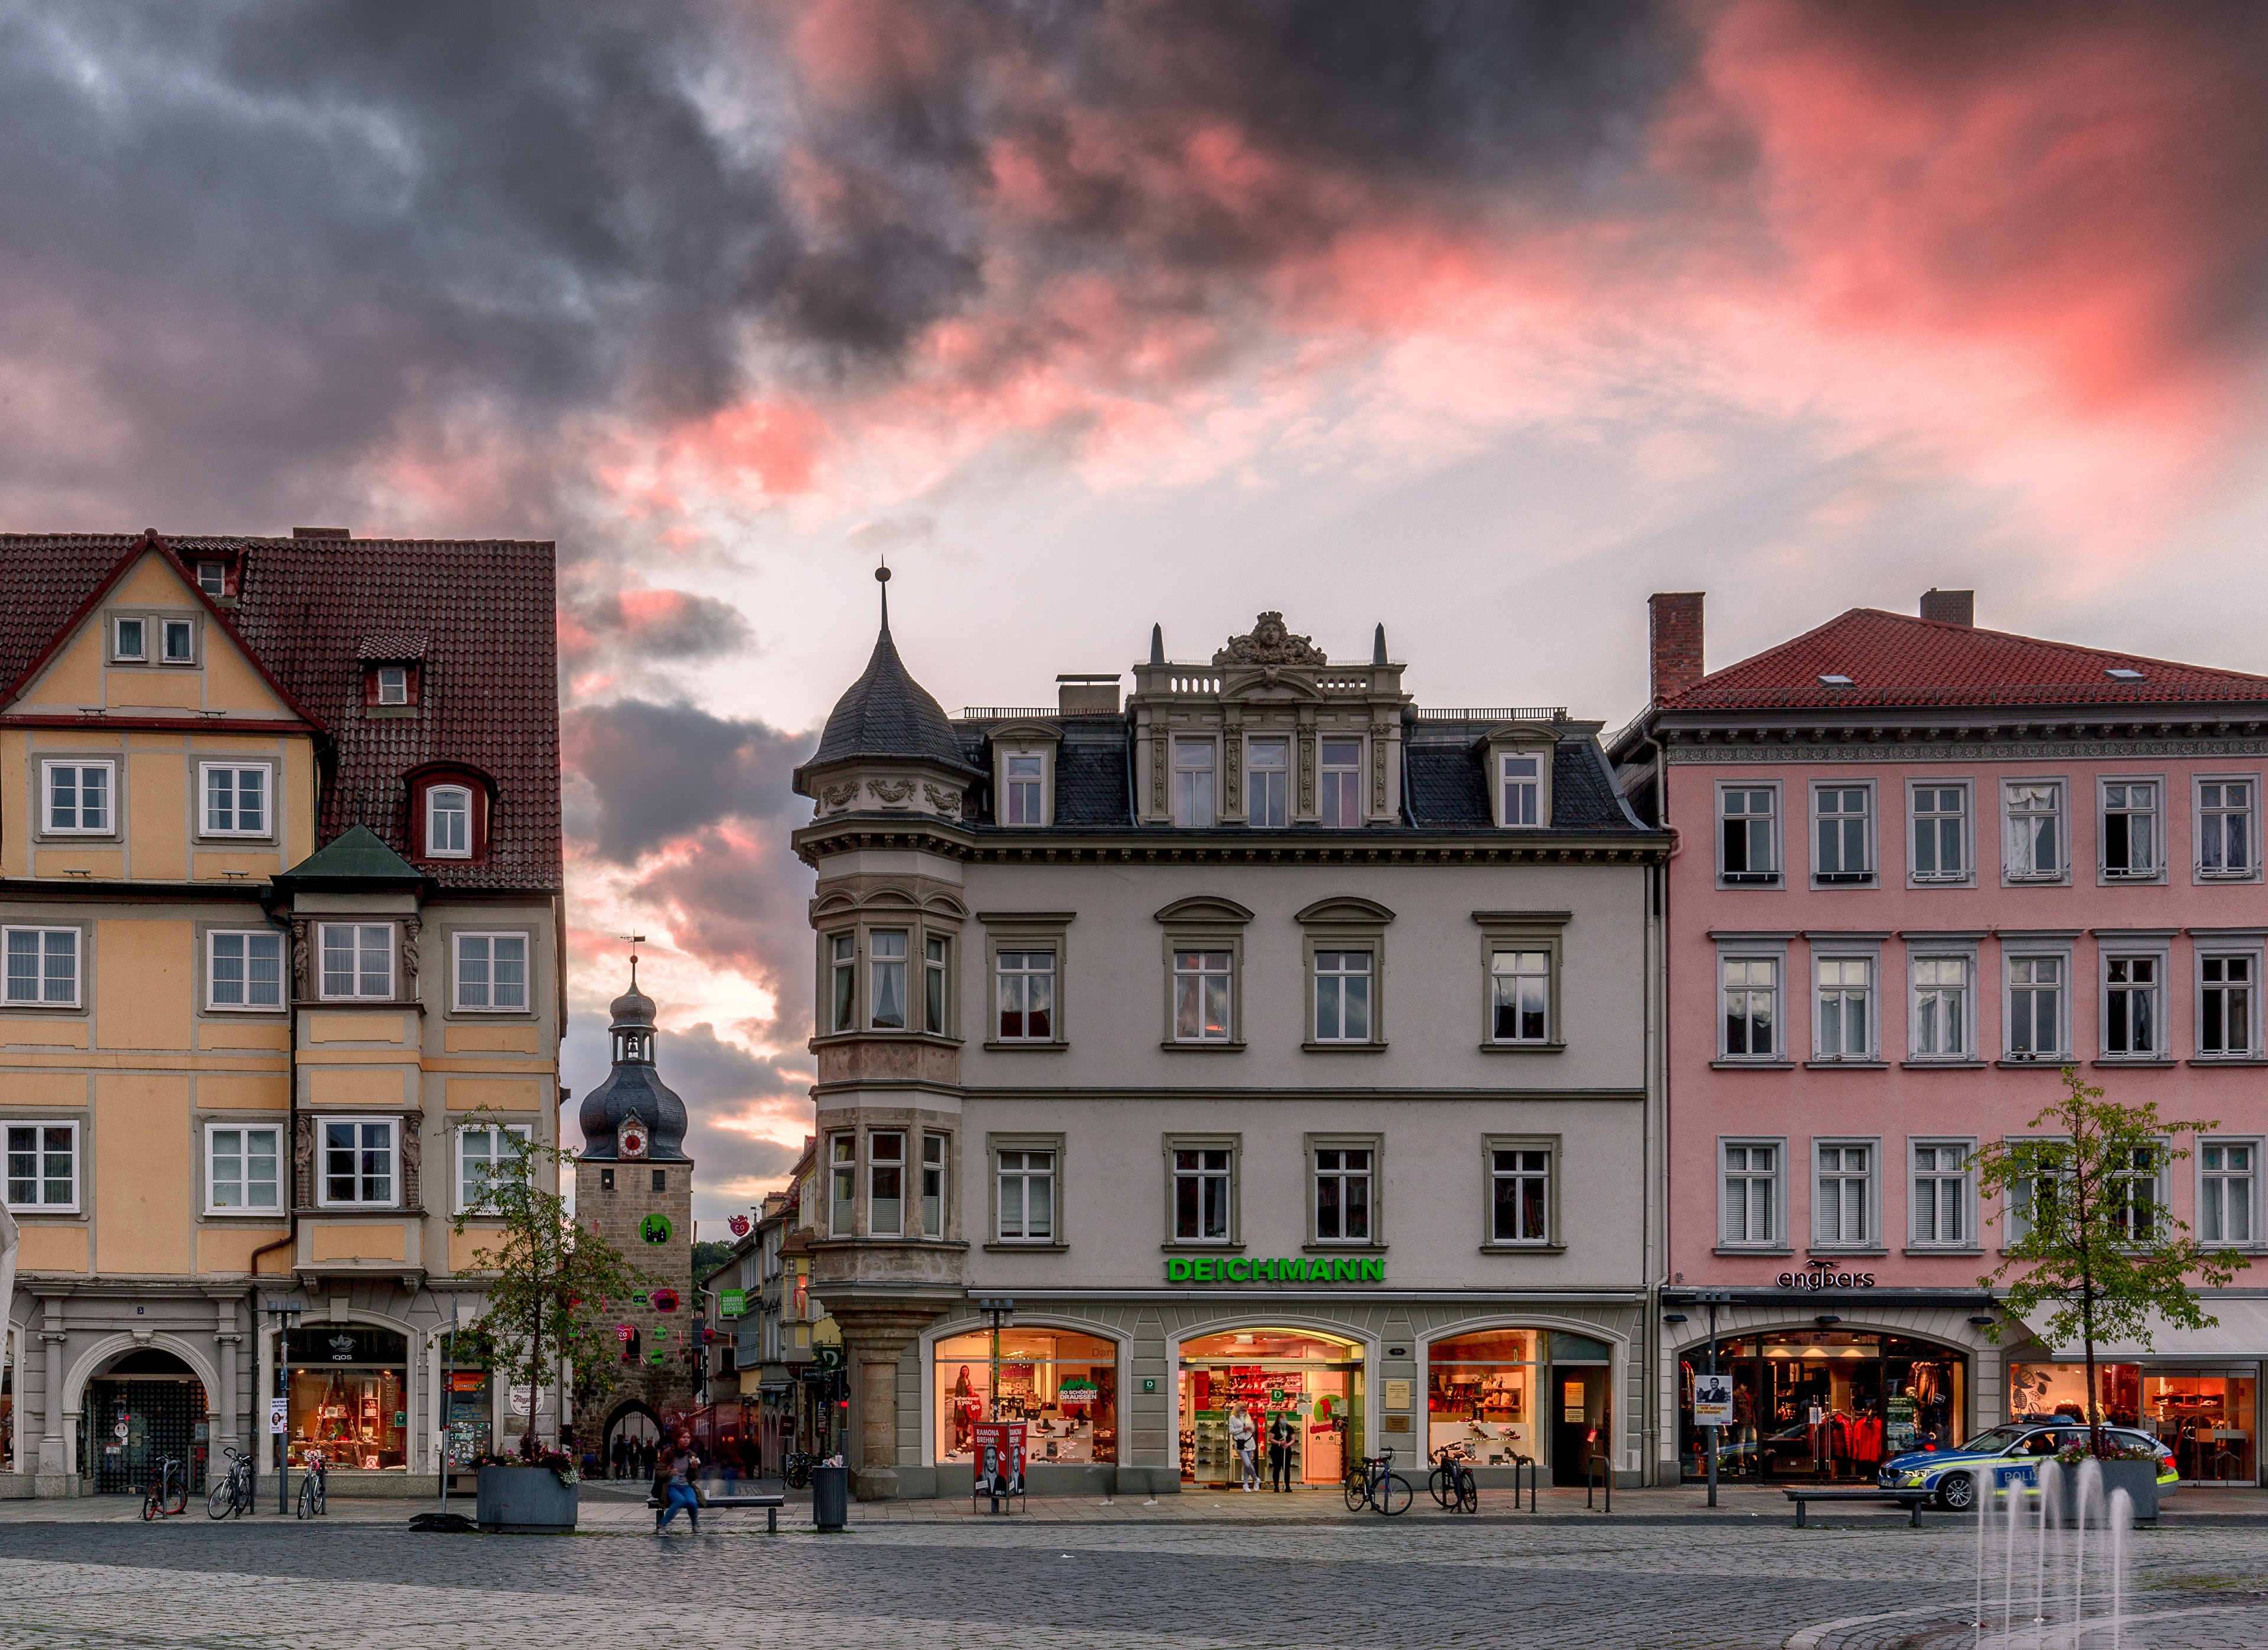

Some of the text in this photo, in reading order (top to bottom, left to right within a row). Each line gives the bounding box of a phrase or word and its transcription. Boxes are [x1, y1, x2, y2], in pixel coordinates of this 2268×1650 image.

[1168, 1258, 1384, 1281] DEICHMANN
[1777, 1267, 1875, 1292] engbers
[513, 1394, 540, 1404] Feylr
